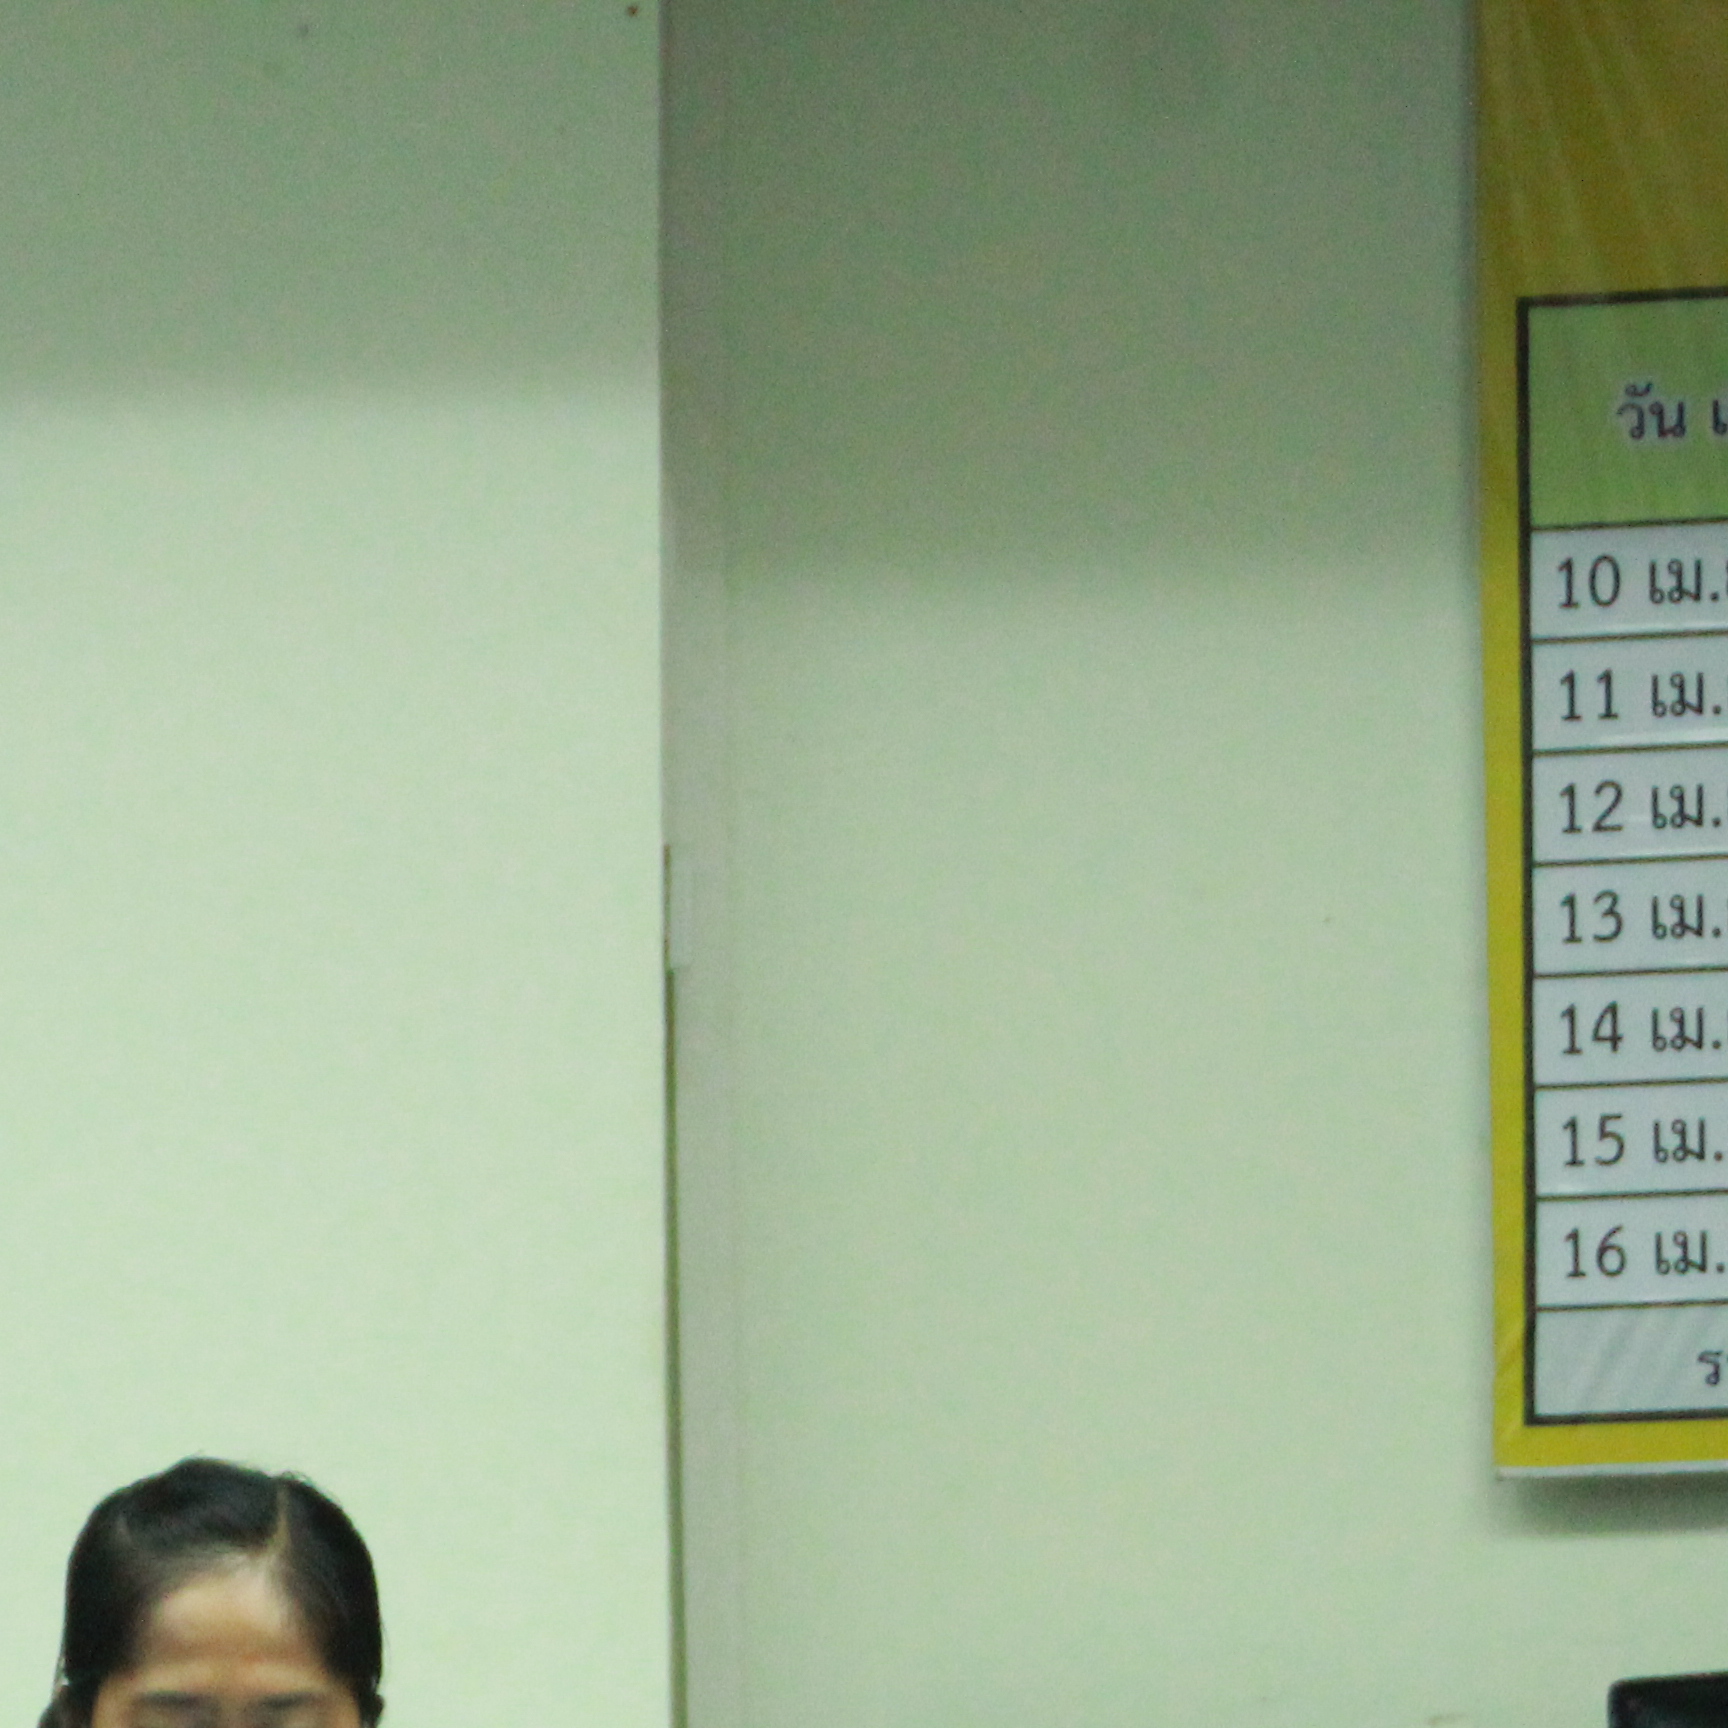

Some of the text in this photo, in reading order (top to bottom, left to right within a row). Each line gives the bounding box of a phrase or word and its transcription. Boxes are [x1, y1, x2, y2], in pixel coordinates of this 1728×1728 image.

[1617, 381, 1687, 440] วัน
[1557, 554, 1728, 608] 10 เม.
[1559, 669, 1620, 722] 11
[1559, 780, 1624, 834] 12
[1560, 890, 1625, 944] 13
[1560, 1002, 1624, 1055] 14
[1562, 1113, 1626, 1167] 15
[1564, 1224, 1628, 1279] 16
